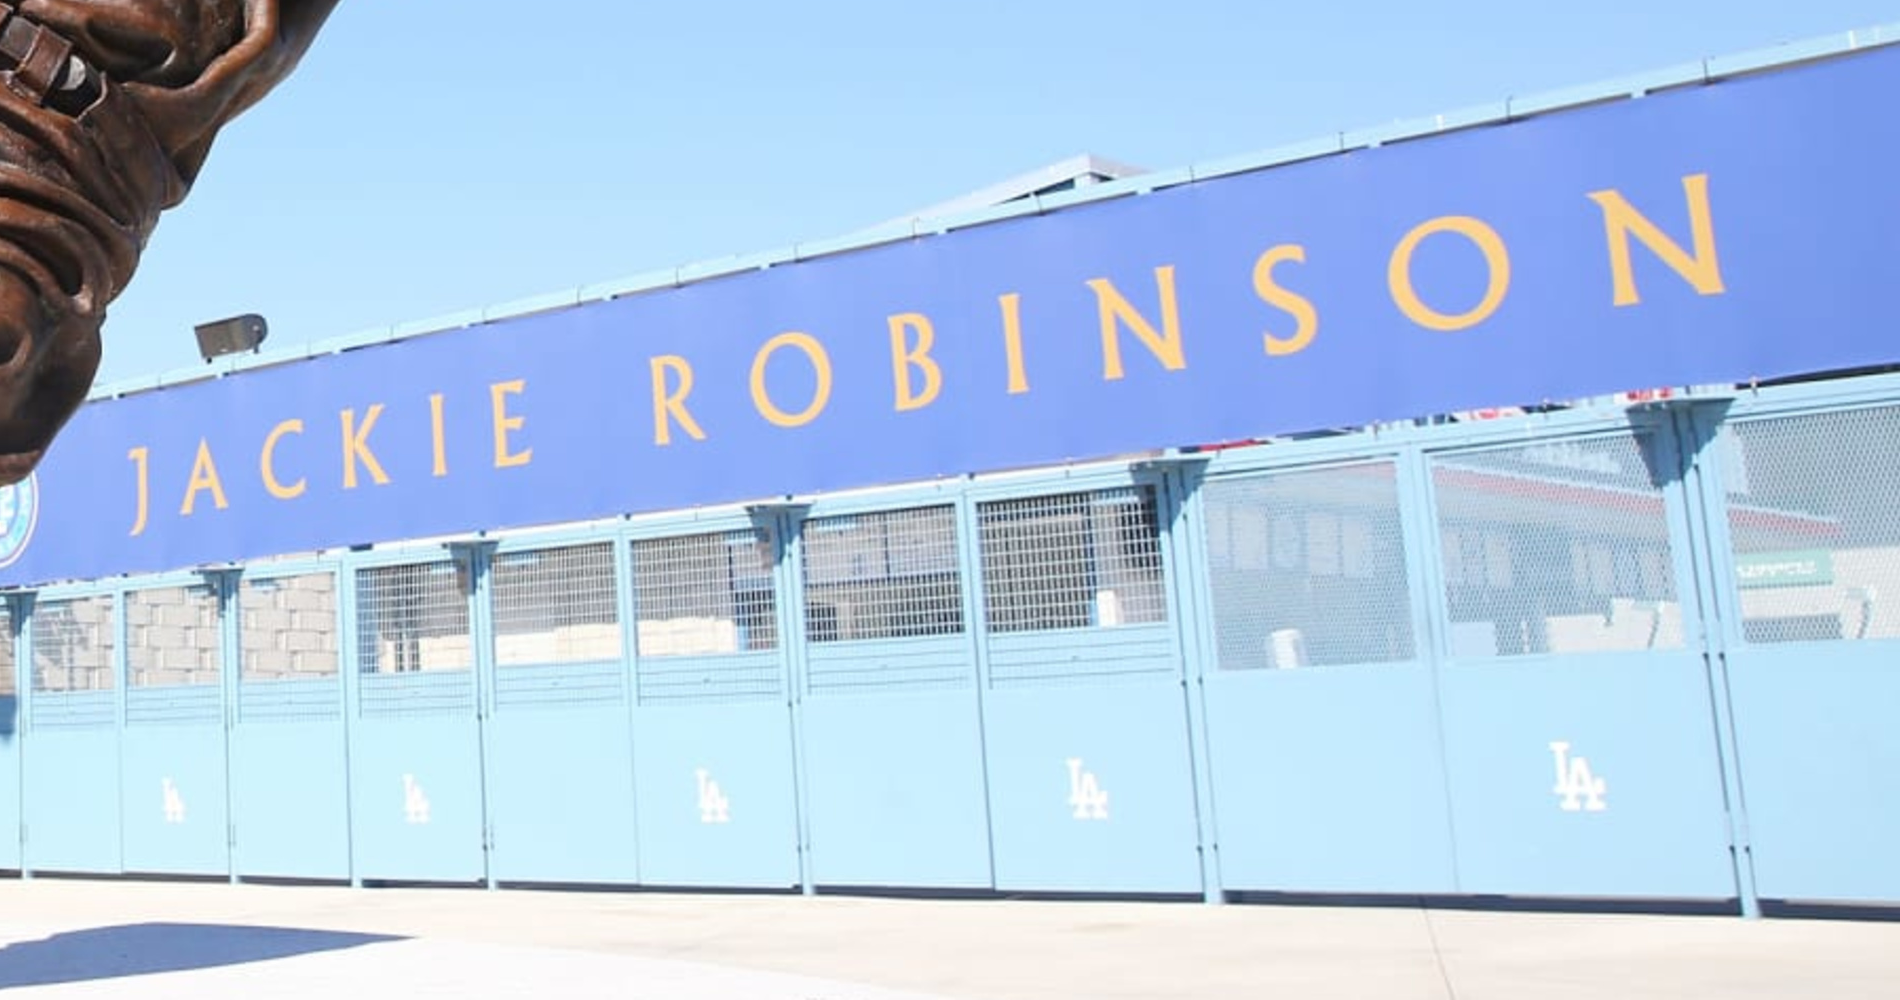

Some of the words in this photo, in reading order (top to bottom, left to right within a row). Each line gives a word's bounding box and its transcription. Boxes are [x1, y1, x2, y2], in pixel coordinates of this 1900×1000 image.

[129, 378, 533, 537] JACKIE
[648, 174, 1726, 447] ROBINSON
[403, 773, 431, 824] LA
[695, 768, 731, 824] LA
[1066, 756, 1110, 821] LA
[1549, 741, 1606, 812] LA
